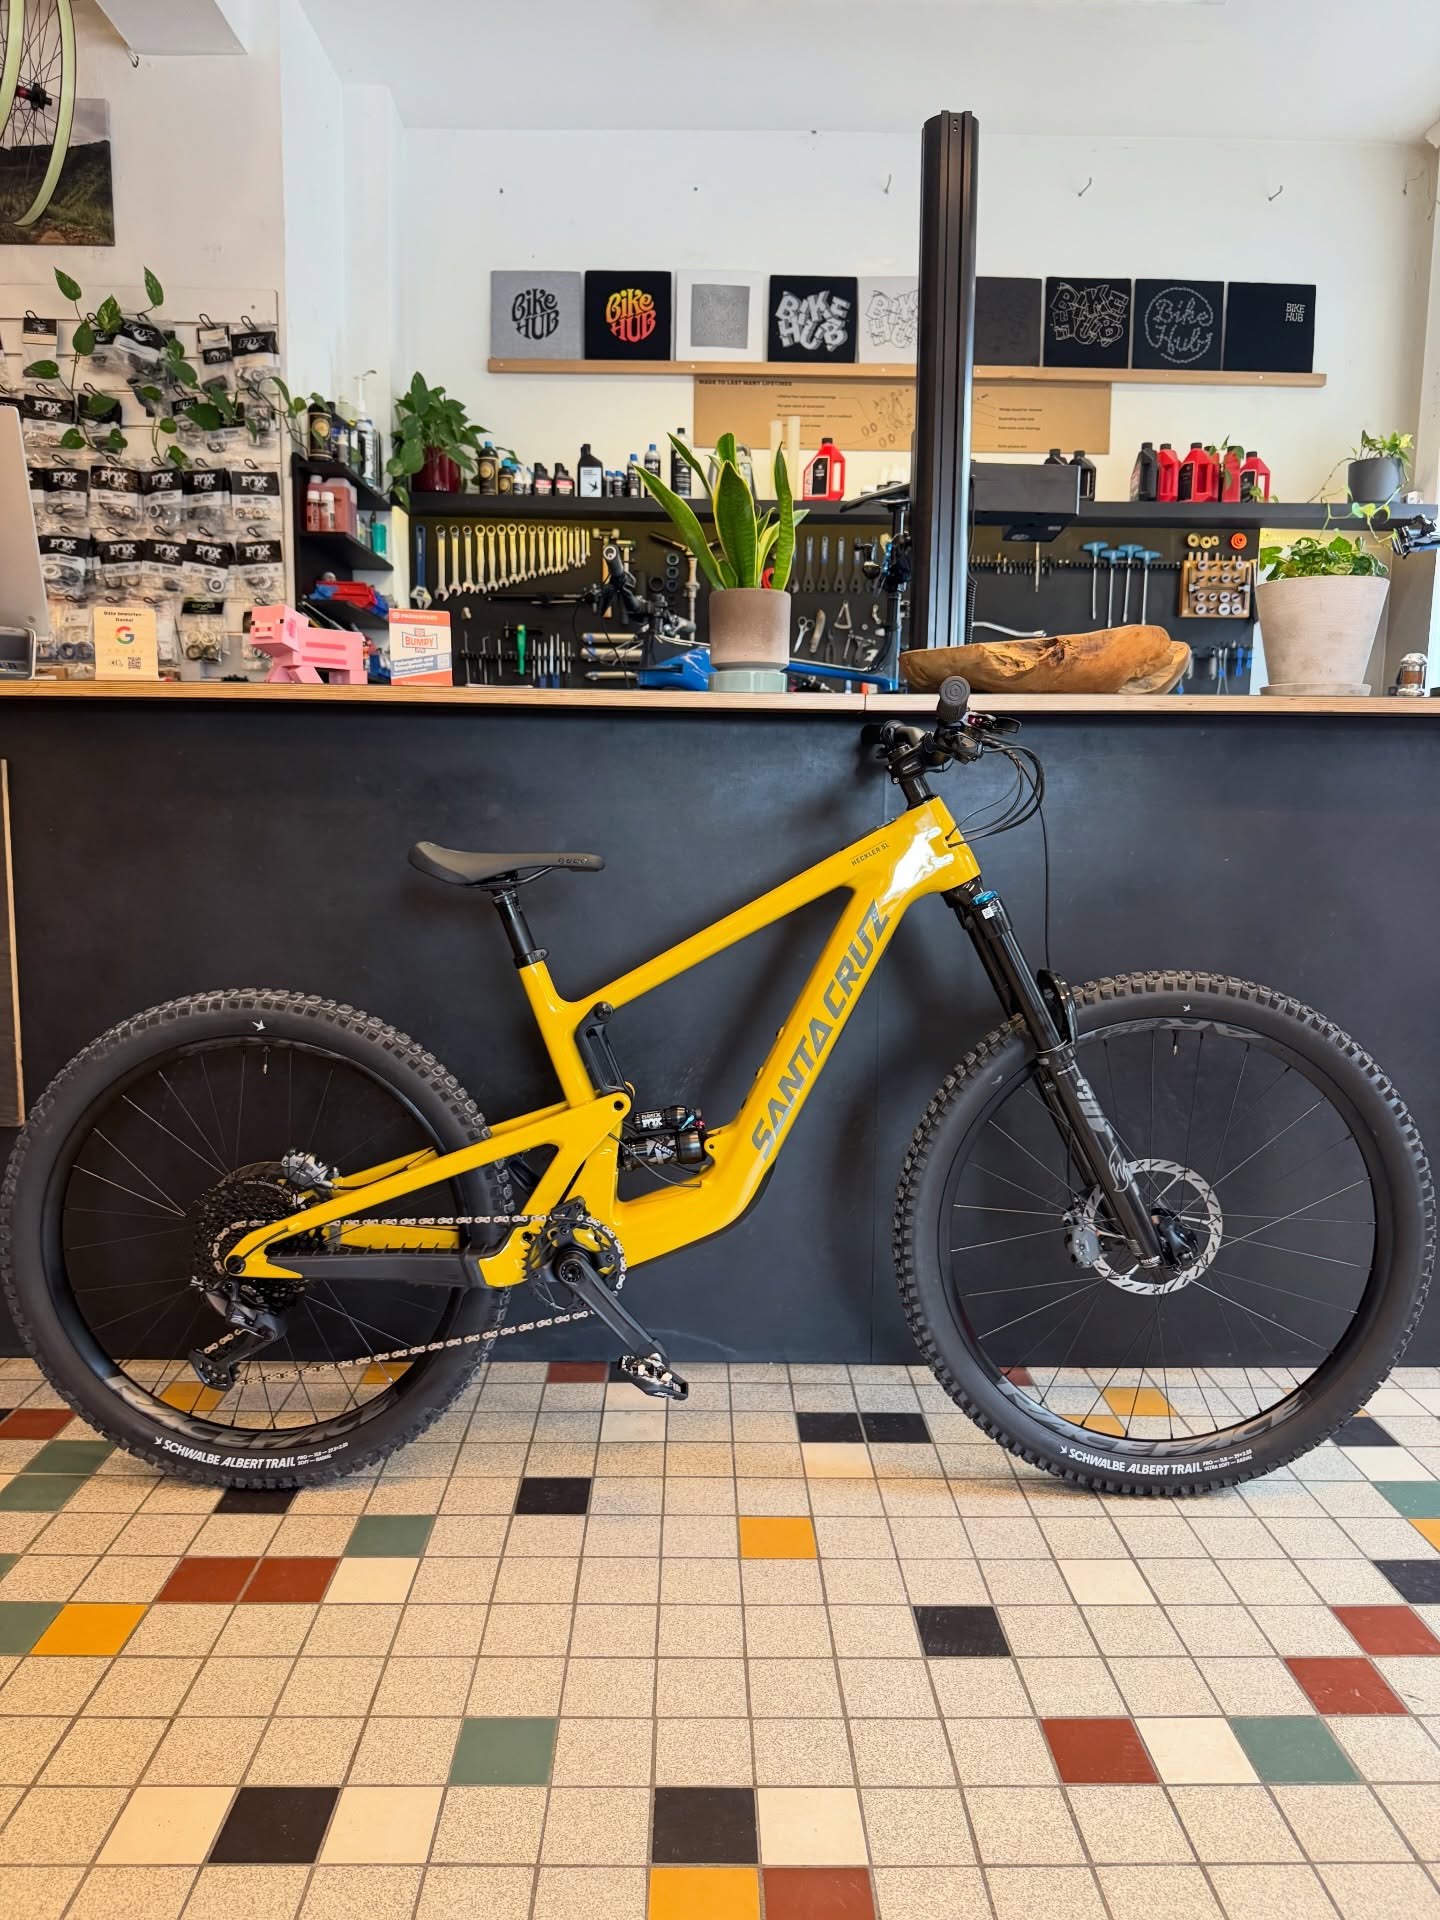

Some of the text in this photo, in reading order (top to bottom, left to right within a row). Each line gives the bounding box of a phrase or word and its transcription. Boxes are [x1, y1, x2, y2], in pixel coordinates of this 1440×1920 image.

[512, 288, 558, 322] Bike
[606, 288, 654, 323] Bike
[775, 290, 851, 327] BIKE
[1050, 282, 1129, 318] BIKE
[1285, 303, 1306, 314] BIKE
[1154, 297, 1213, 328] Bike
[1285, 312, 1304, 323] HUB
[516, 309, 560, 340] HUB
[610, 309, 657, 342] HUB
[1051, 311, 1124, 347] HUB
[239, 336, 266, 350] FOX
[777, 317, 849, 352] HUB
[1150, 322, 1213, 355] Hub
[34, 400, 62, 418] FOX
[53, 471, 78, 488] FOX
[100, 470, 128, 491] FOX
[151, 473, 173, 489] FOX
[193, 473, 216, 489] FOX
[241, 475, 268, 492] FOX
[49, 538, 77, 554] FOX
[109, 543, 136, 559] FOX
[154, 543, 180, 560] FOX
[195, 544, 222, 563] FOX
[245, 544, 271, 560] FOX
[405, 635, 434, 647] BUMPY
[851, 846, 881, 867] HECKLER
[752, 898, 890, 1161] SANTA CRUZ
[641, 1117, 663, 1129] FOX
[655, 1142, 674, 1157] FLOAT
[162, 1439, 296, 1470] SCHWALBE ALBERT TRAIL
[1068, 1448, 1203, 1476] SCHWALBE ALBERT TRAIL
[1202, 1459, 1214, 1467] PRO
